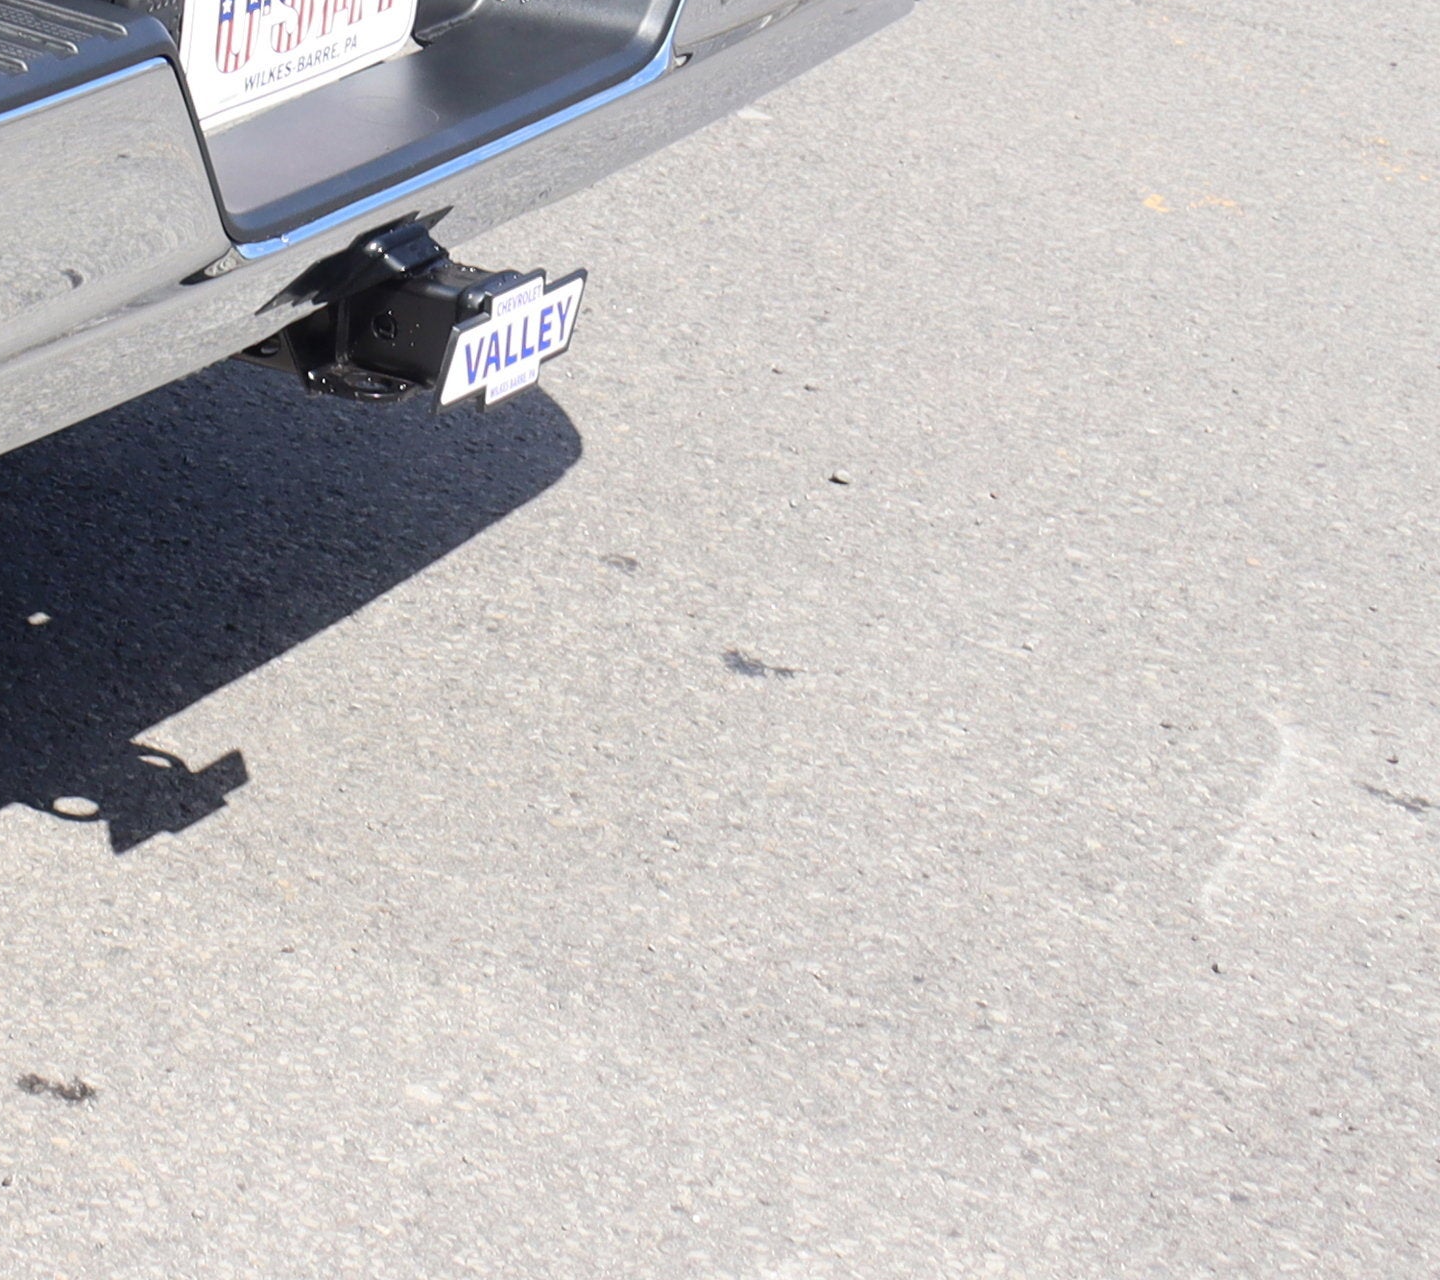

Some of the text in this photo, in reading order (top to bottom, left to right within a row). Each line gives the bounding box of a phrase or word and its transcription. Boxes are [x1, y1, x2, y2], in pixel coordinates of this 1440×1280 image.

[344, 34, 359, 54] PA
[497, 285, 542, 317] CHEVROLET
[465, 295, 573, 385] VALLEY
